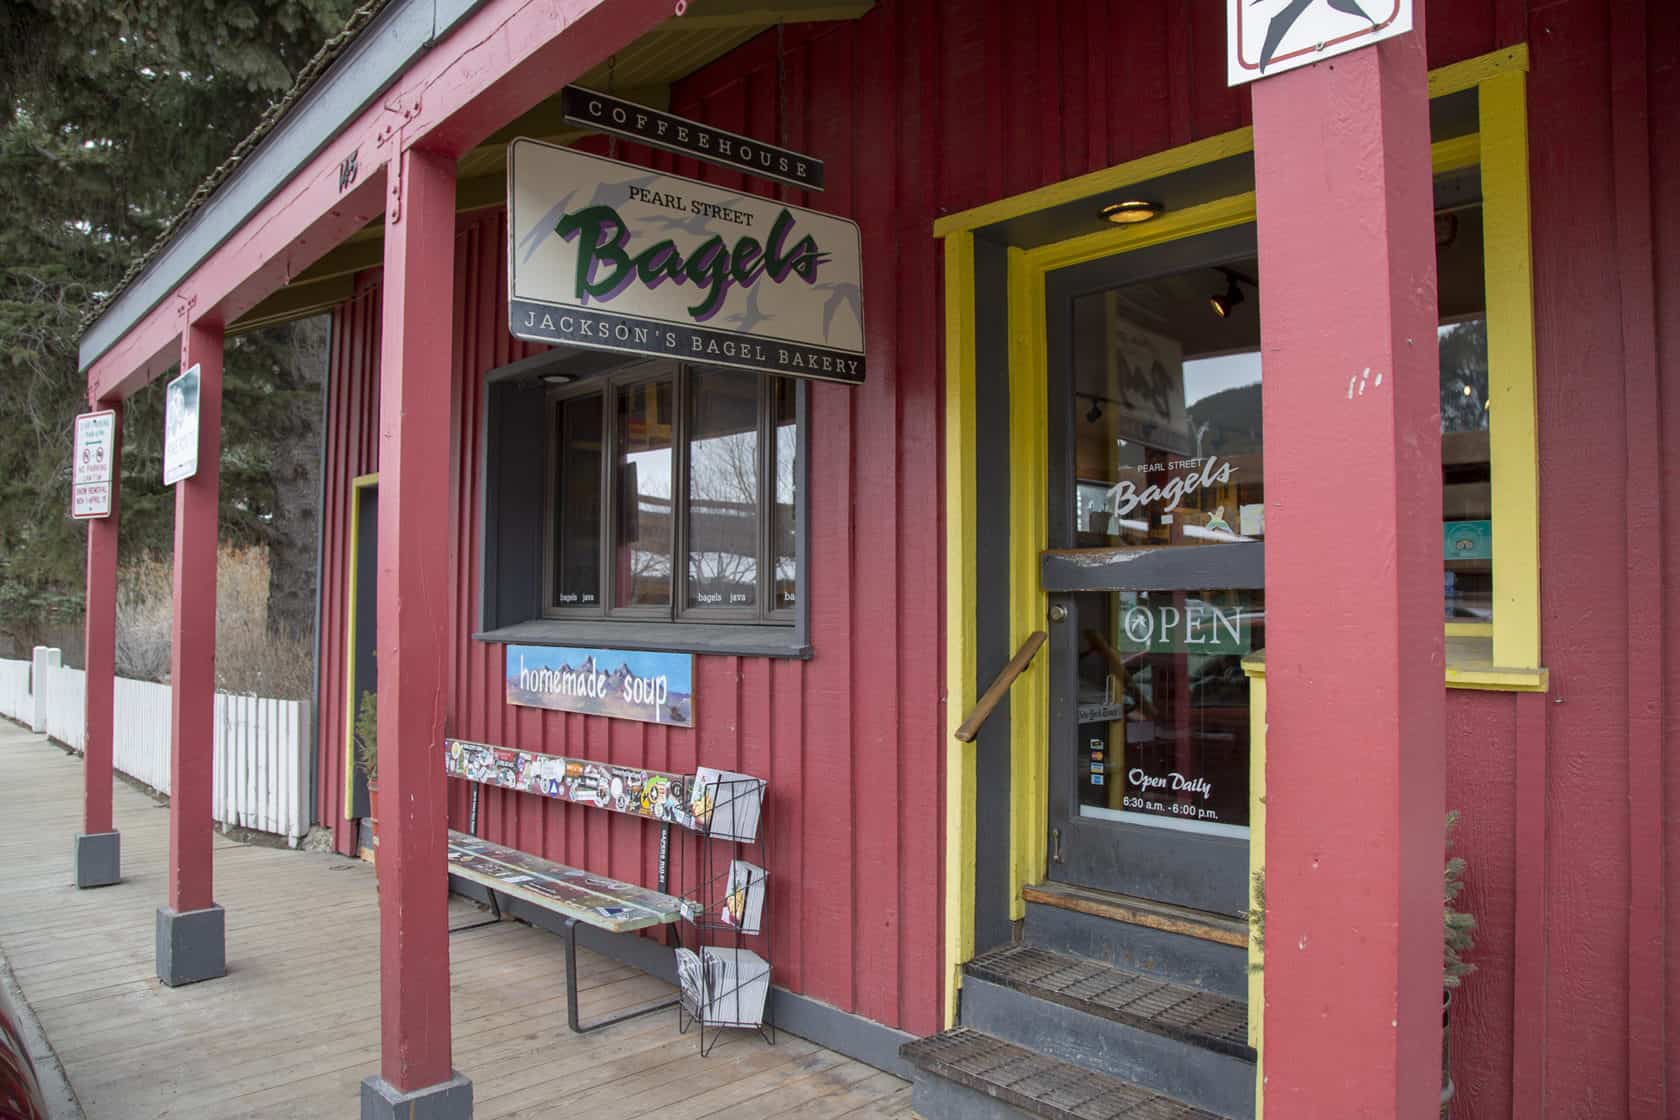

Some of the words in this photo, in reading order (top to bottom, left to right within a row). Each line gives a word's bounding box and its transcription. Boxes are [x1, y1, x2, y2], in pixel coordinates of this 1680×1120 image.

[588, 100, 808, 178] COFFEEHOUSE
[628, 185, 687, 213] PEARL
[690, 197, 754, 227] STREET
[554, 206, 832, 322] Bagels
[523, 310, 678, 348] JACKSON'S
[690, 335, 767, 362] BAGEL
[778, 350, 860, 376] BAKERY
[1105, 455, 1240, 518] Bagels
[1136, 461, 1166, 474] PEARL
[1167, 457, 1202, 471] STREET
[697, 591, 722, 604] bagels
[729, 591, 747, 604] java
[1124, 605, 1243, 646] OPEN
[519, 654, 607, 699] homemade
[623, 673, 668, 722] soup
[1128, 767, 1168, 793] Open
[1168, 772, 1212, 800] Daily
[1122, 796, 1144, 809] 6:30
[1145, 801, 1166, 812] a.m.
[1198, 807, 1219, 820] p.m.
